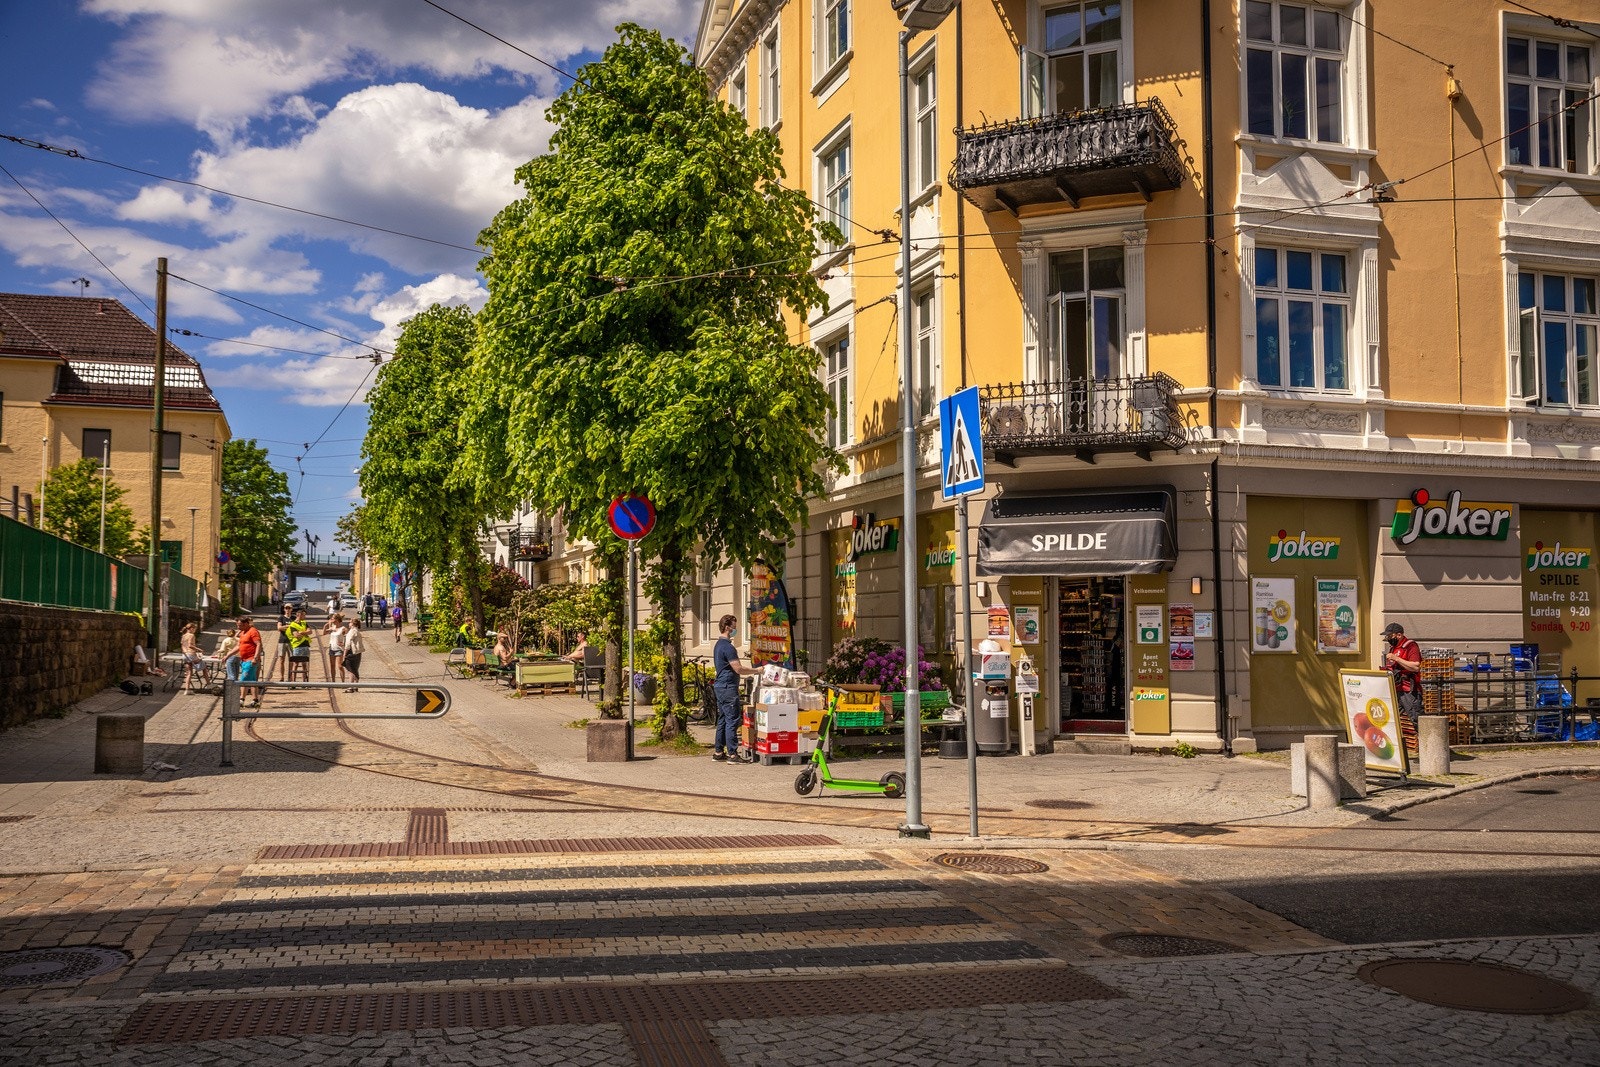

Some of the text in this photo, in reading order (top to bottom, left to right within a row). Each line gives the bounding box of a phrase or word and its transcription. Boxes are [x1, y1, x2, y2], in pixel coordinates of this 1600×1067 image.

[1402, 488, 1511, 545] joker
[847, 512, 890, 561] joker
[1031, 532, 1108, 552] SPILDE
[1270, 529, 1337, 563] joker
[926, 541, 955, 571] joker
[1528, 541, 1588, 572] joker
[1540, 574, 1580, 586] SPILDE
[1529, 591, 1590, 602] Man-fre 8-21
[1530, 606, 1591, 618] Lørdag 9-20
[1530, 621, 1591, 633] Søndag 9-20
[1138, 689, 1165, 701] joker
[1371, 706, 1383, 718] 20
